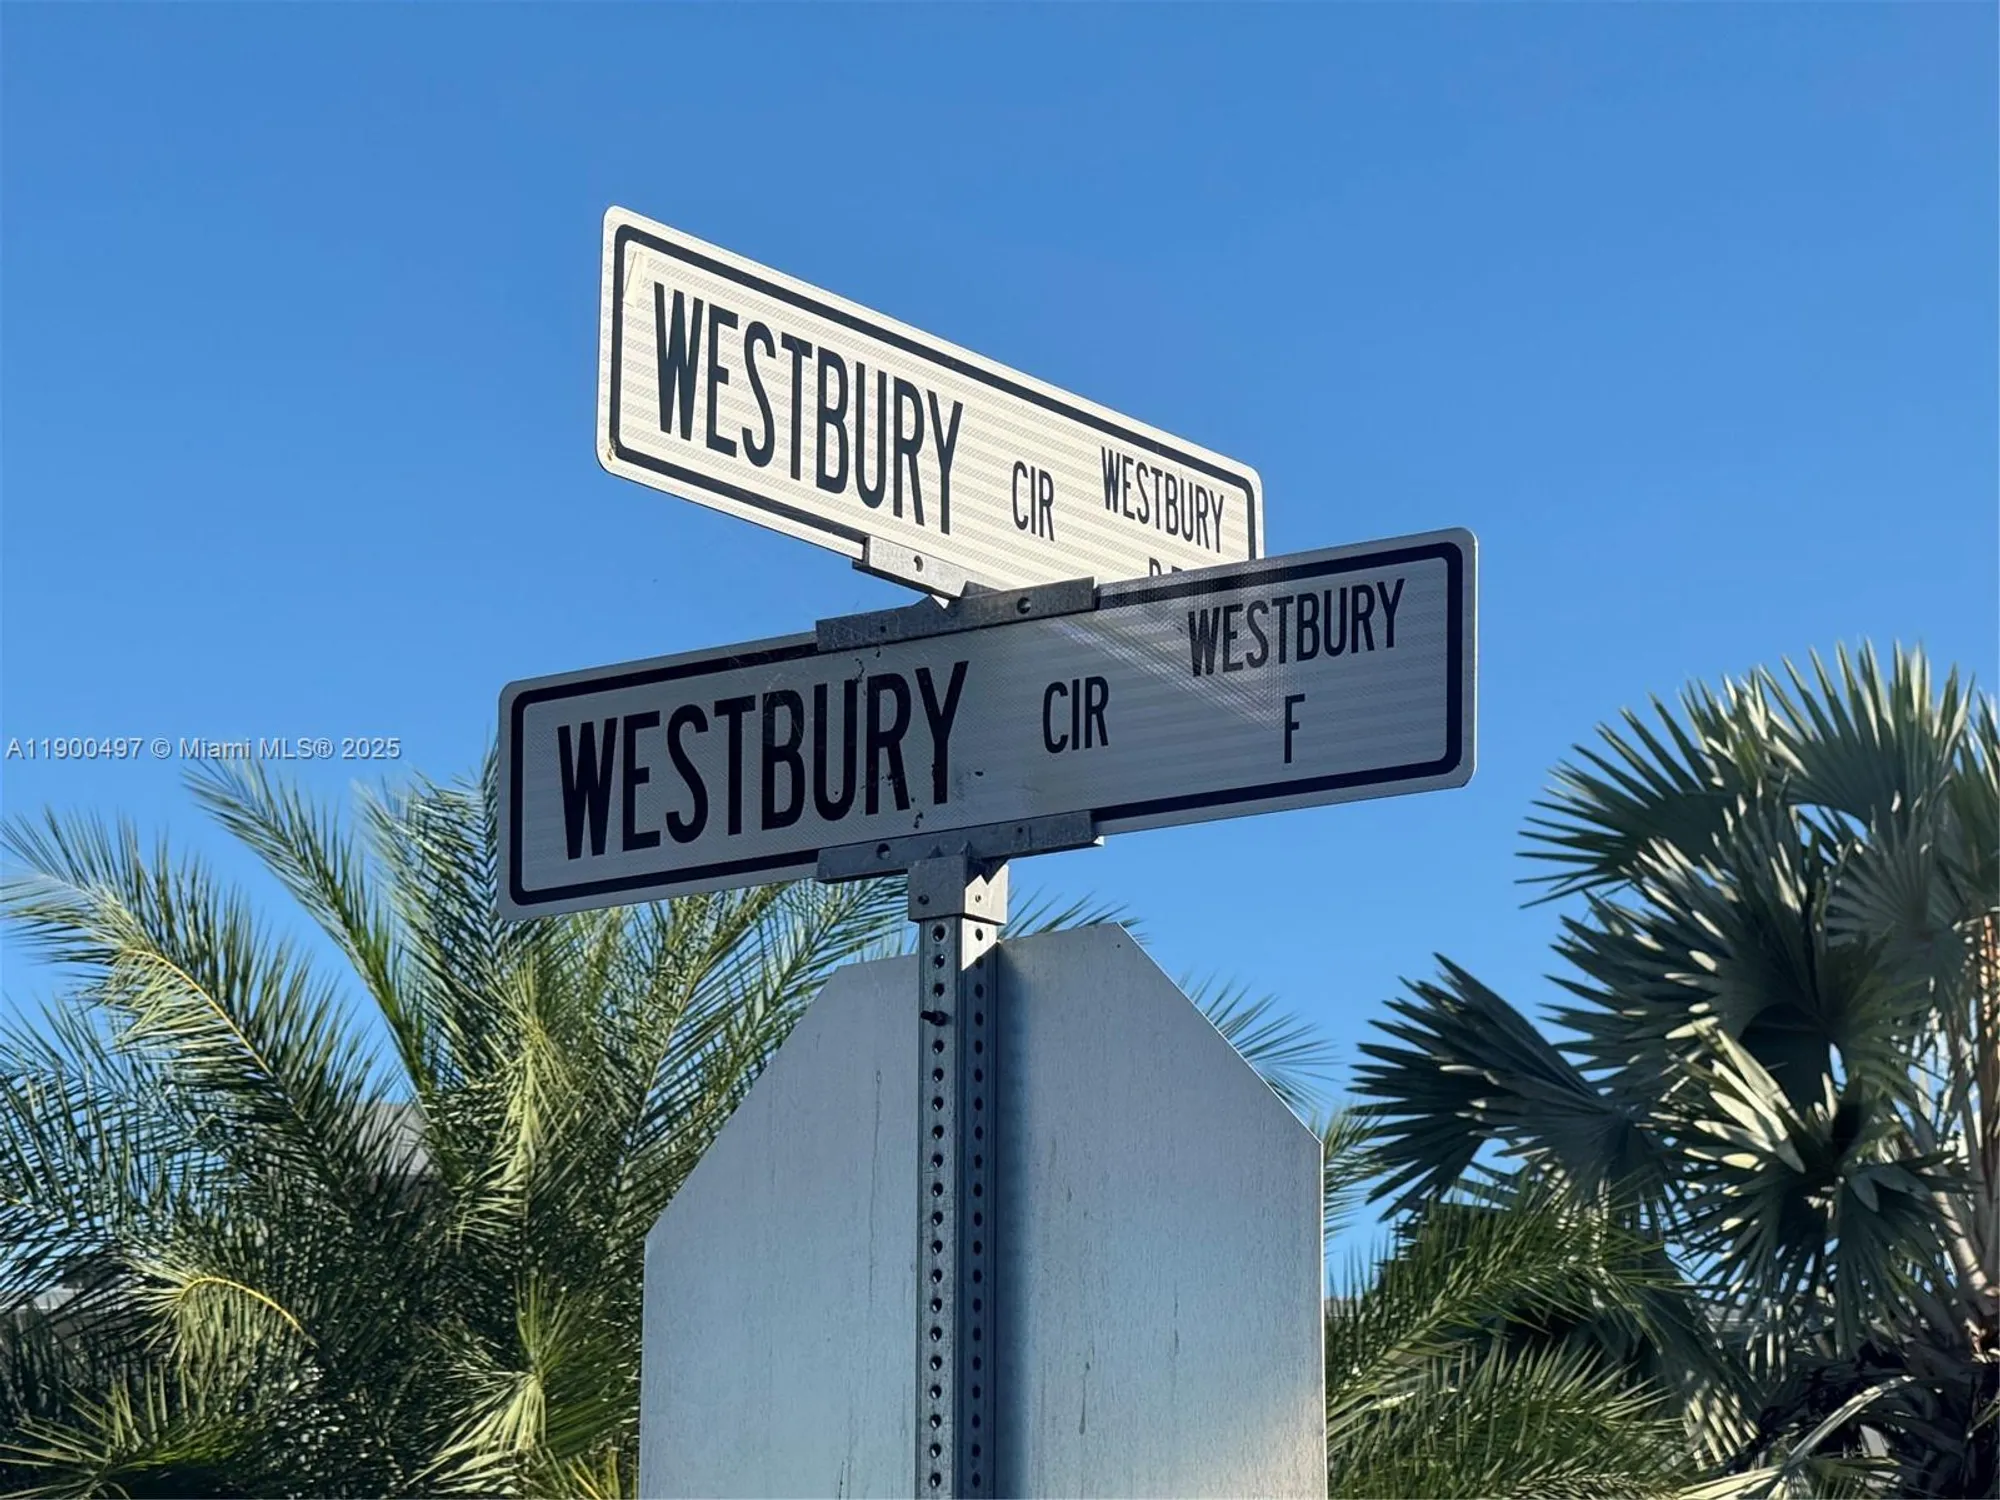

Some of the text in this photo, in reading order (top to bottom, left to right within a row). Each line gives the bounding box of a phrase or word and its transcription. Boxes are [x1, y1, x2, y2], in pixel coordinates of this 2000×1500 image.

[654, 282, 1055, 541] WESTBURY CIR
[1101, 446, 1224, 553] WESTBURY
[1188, 578, 1405, 677] WESTBURY
[557, 660, 1109, 861] WESTBURY CIR
[1283, 694, 1305, 763] F
